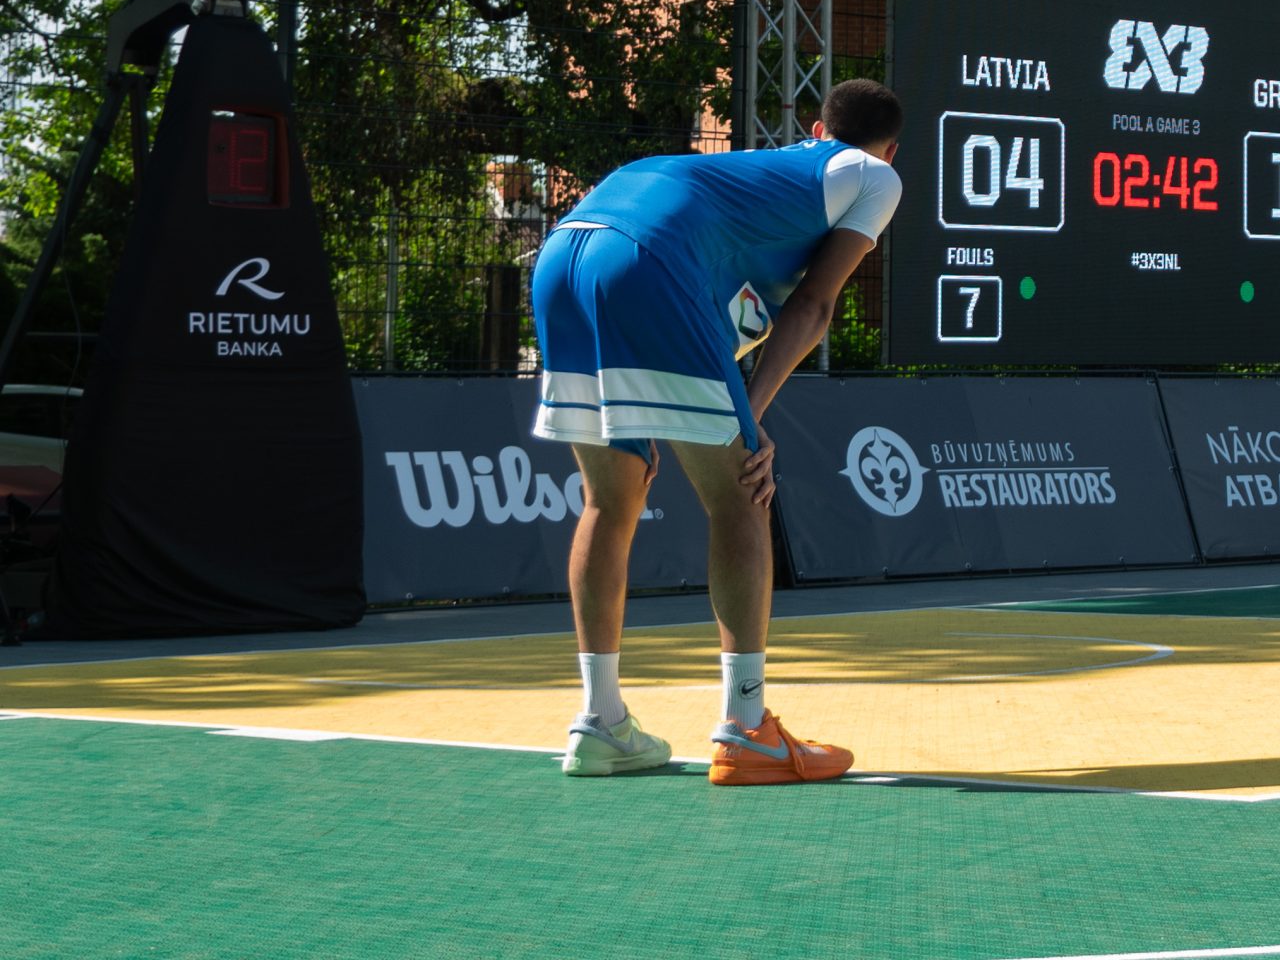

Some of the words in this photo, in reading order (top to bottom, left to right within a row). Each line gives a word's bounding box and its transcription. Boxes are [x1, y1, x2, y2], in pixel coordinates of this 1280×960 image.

[962, 55, 1050, 91] LATVIA
[1112, 114, 1143, 131] POOL
[1145, 116, 1154, 132] A
[1156, 117, 1190, 134] GAME
[1192, 119, 1201, 135] 3
[962, 135, 1044, 208] 04
[1093, 152, 1219, 211] 02:42
[947, 247, 994, 266] FOULS
[1131, 252, 1182, 270] #3X3NL
[959, 287, 981, 329] 7
[189, 312, 310, 335] RIETUMU
[217, 341, 282, 356] BANKA
[931, 441, 1075, 467] BŪVUZŅĒMUMS
[939, 472, 1116, 507] RESTAURATORS
